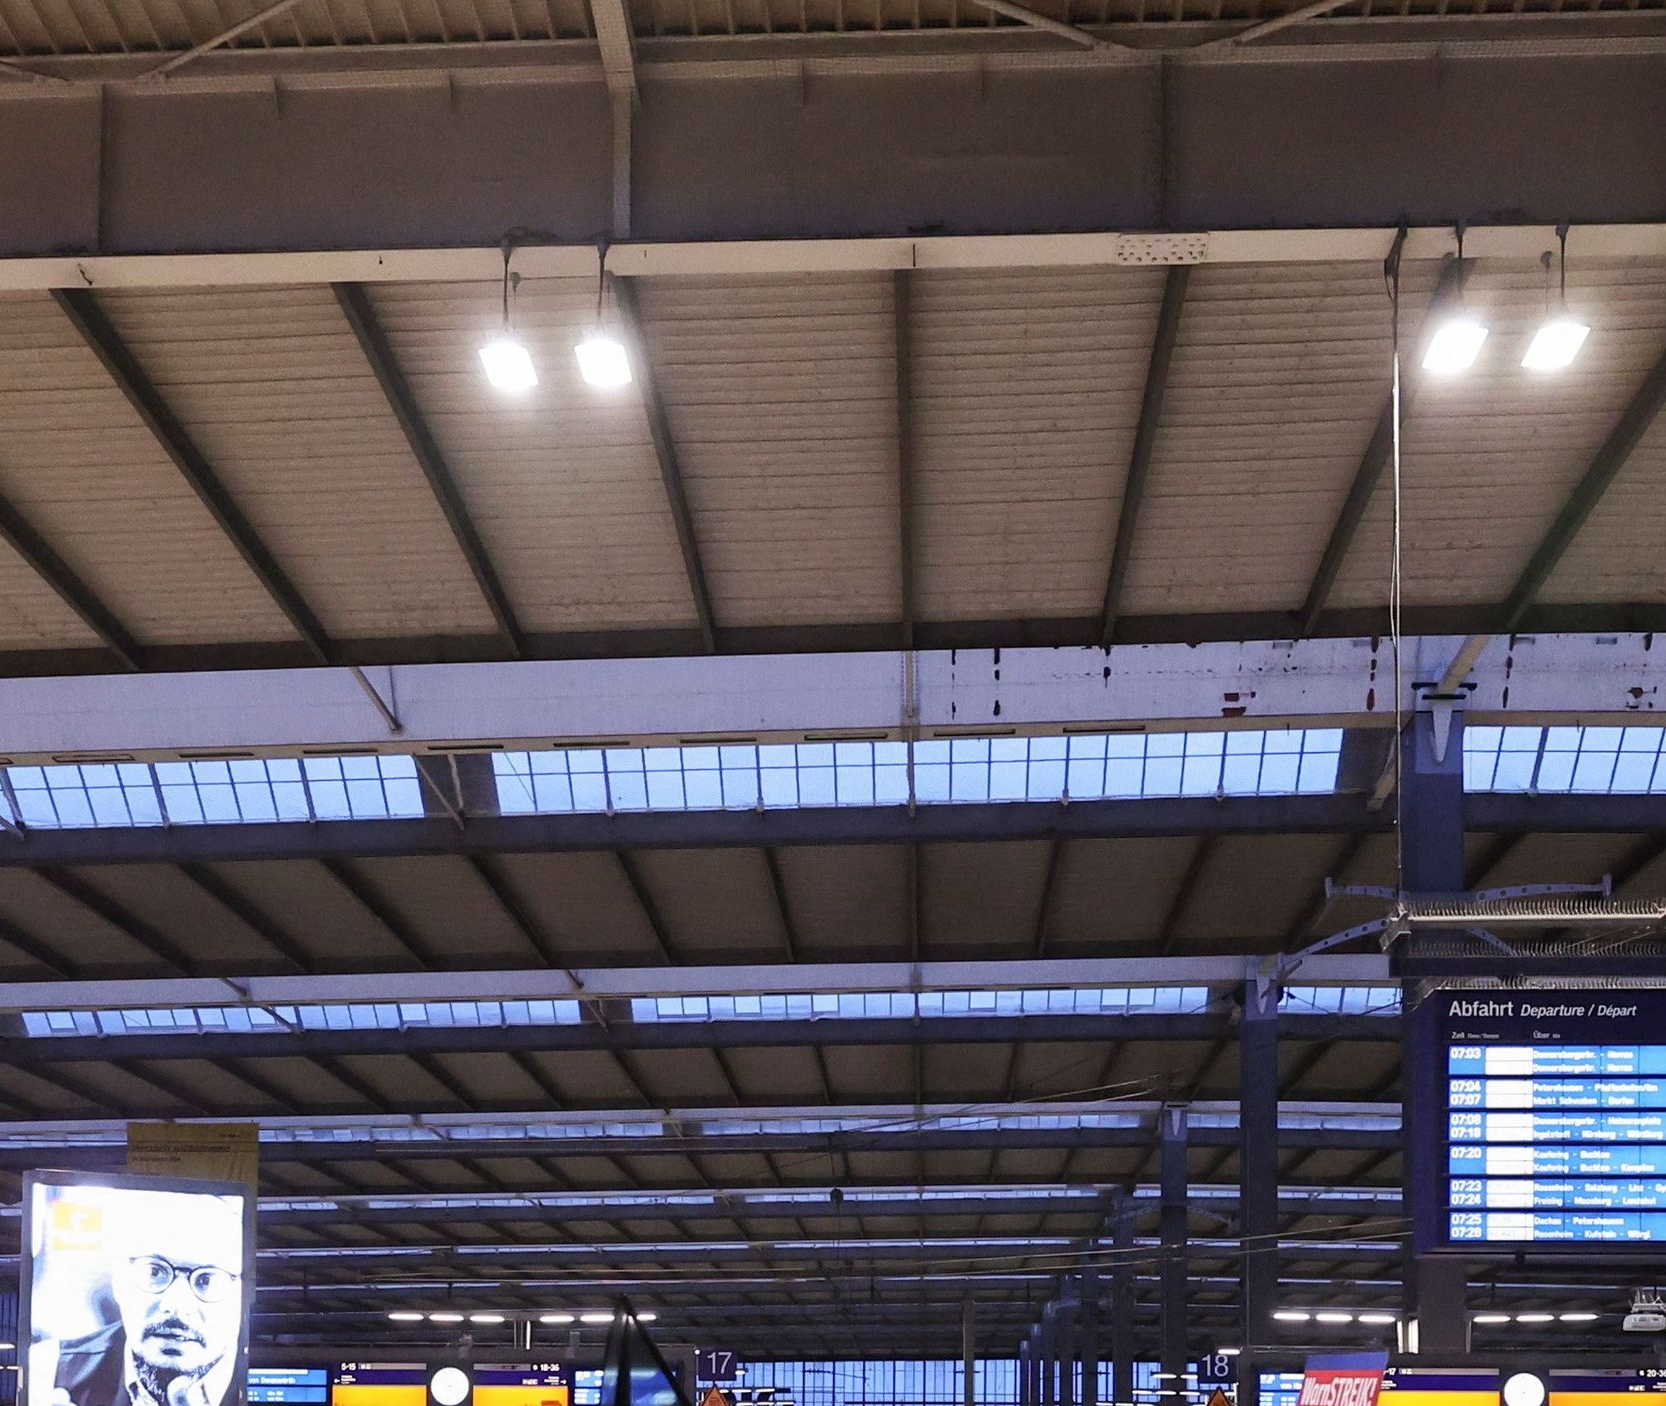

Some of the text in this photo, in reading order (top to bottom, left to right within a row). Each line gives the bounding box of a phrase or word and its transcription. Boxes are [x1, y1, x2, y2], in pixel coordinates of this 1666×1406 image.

[1449, 1001, 1513, 1017] Abfahrt
[1520, 1004, 1584, 1018] Departure
[1597, 1004, 1636, 1018] Départ
[707, 1352, 732, 1374] 17
[1201, 1354, 1229, 1377] 18
